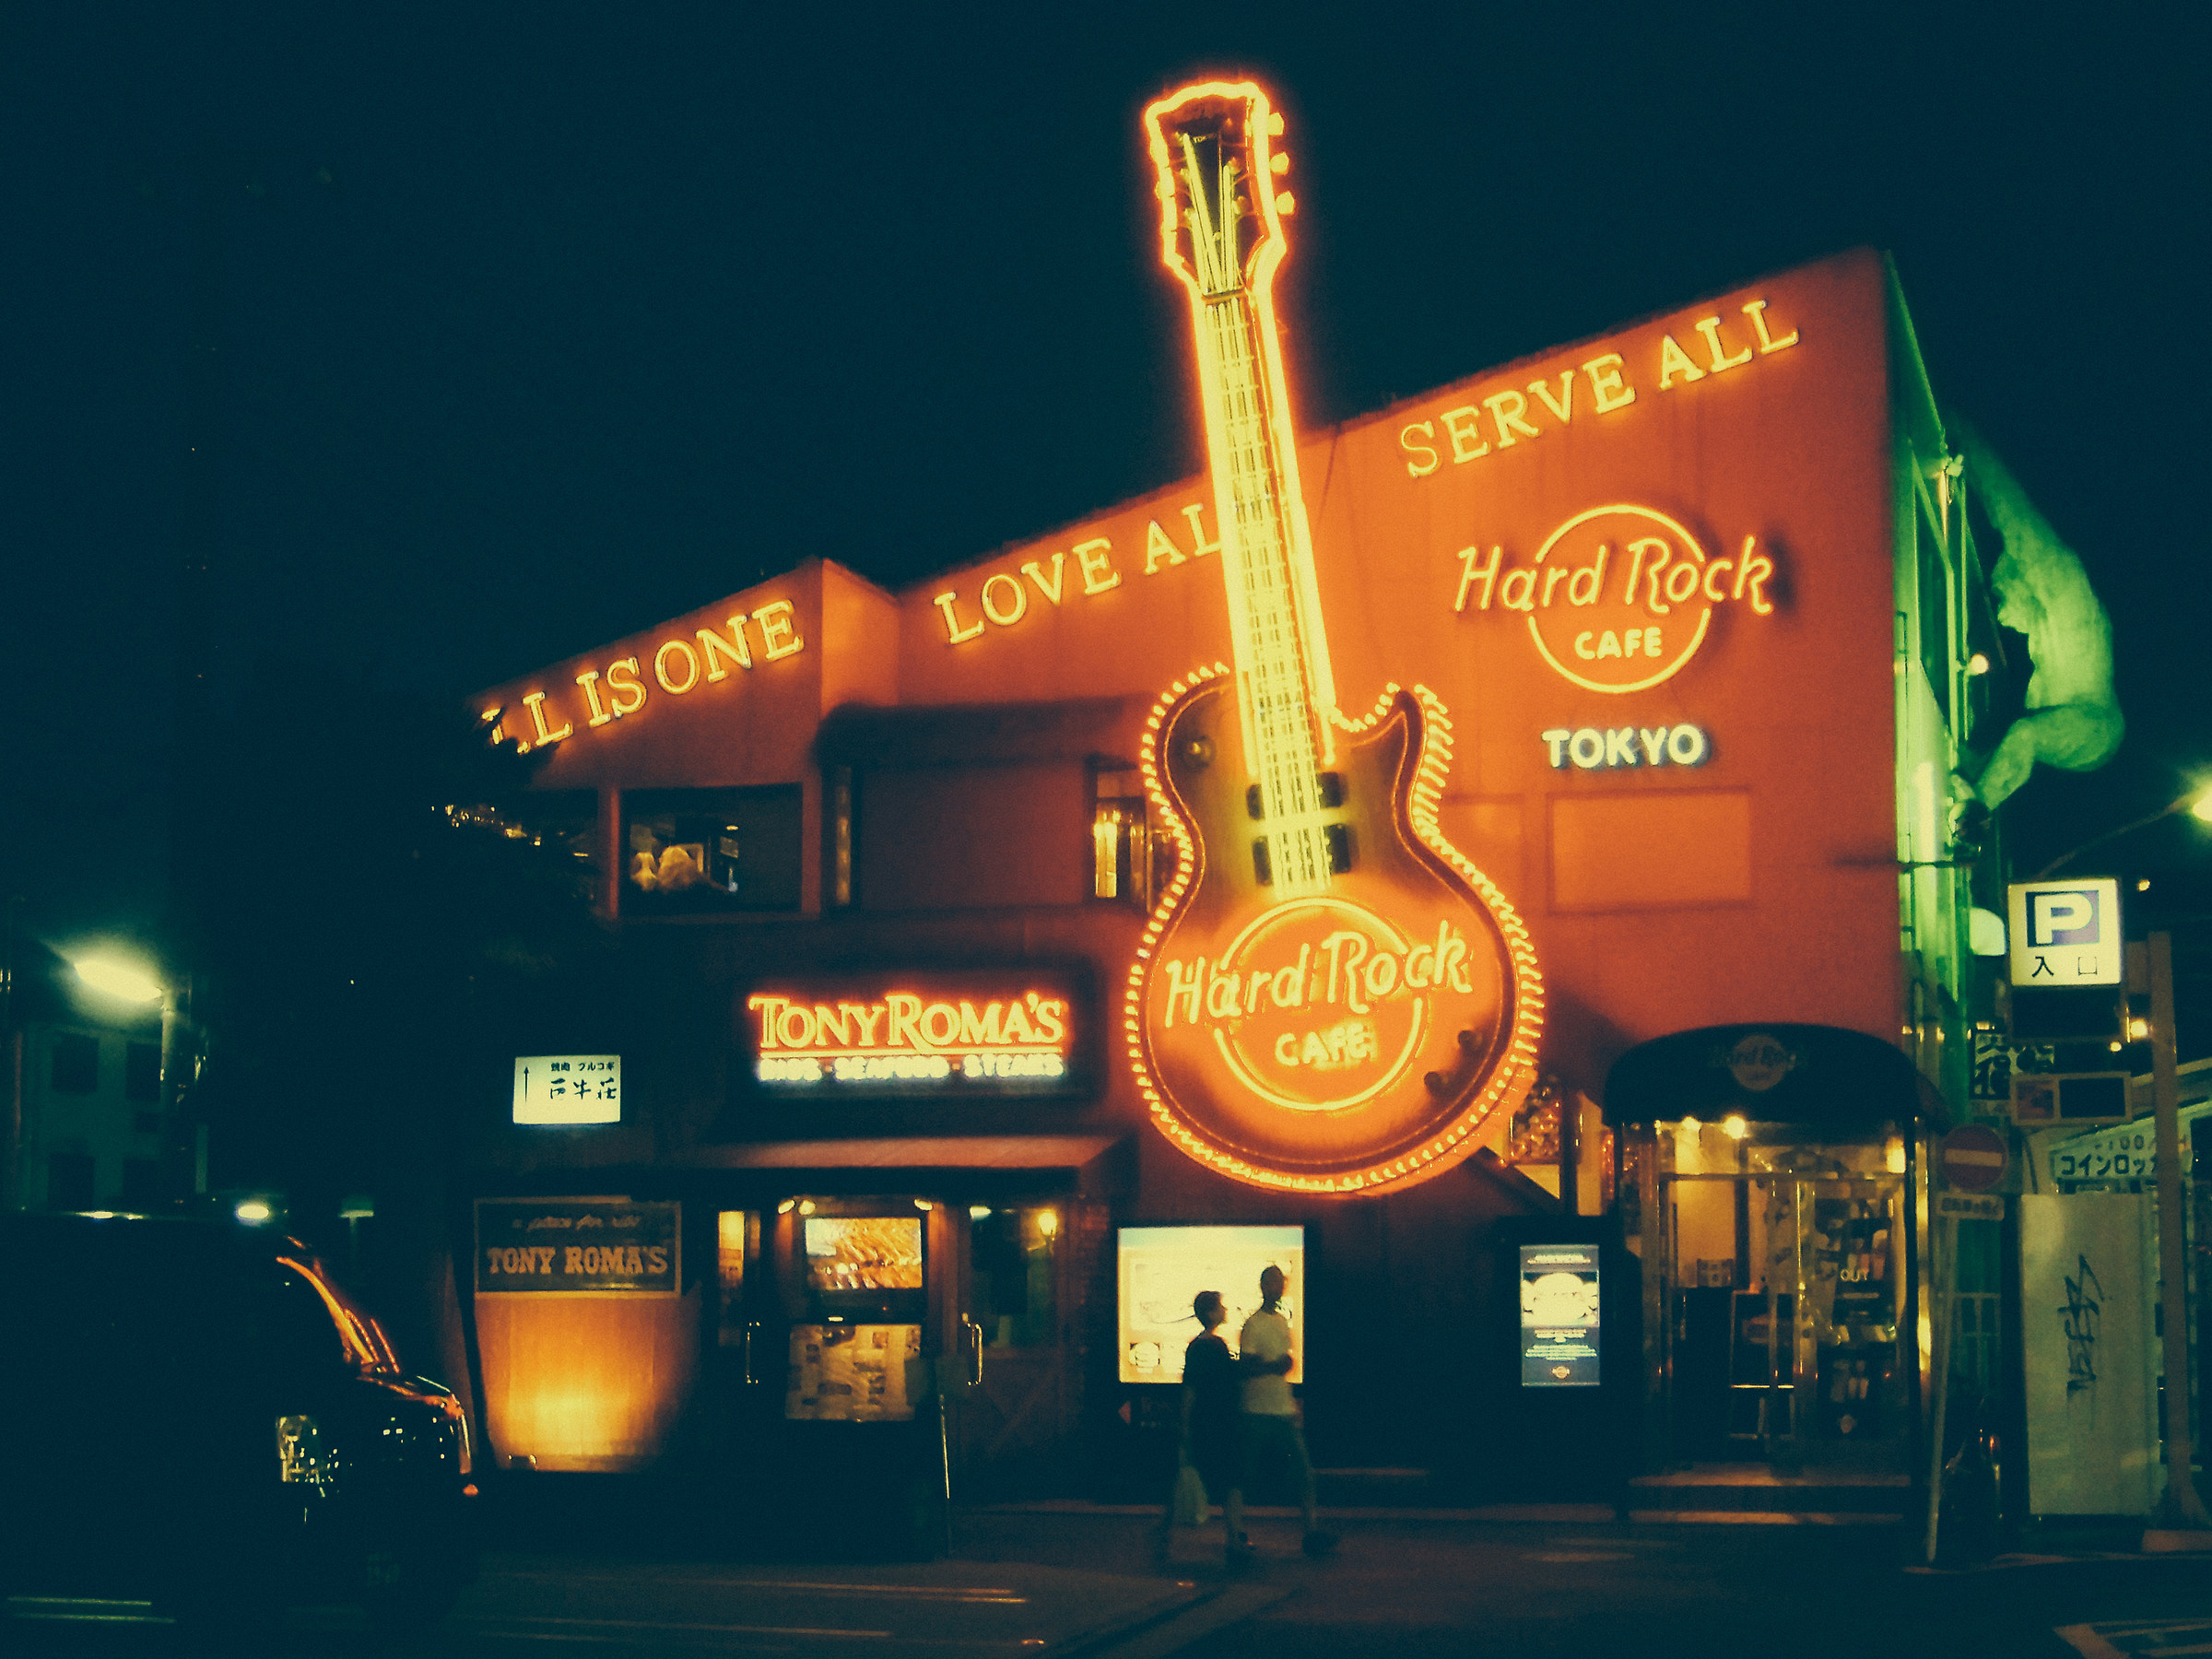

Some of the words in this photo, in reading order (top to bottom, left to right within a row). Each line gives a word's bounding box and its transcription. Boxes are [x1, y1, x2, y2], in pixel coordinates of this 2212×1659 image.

[1400, 353, 1636, 478] SERVE
[1659, 299, 1799, 391] ALL
[933, 537, 1122, 644] LOVE
[1454, 545, 1606, 612] Hard
[1625, 535, 1772, 614] Rock
[653, 599, 805, 695] ONE
[1574, 627, 1662, 659] CAFE
[1542, 724, 1709, 769] TOKYO
[2034, 893, 2094, 945] P
[1165, 943, 1310, 1028] Hard
[1322, 920, 1473, 1014] Rock
[749, 996, 885, 1048] TONY
[885, 992, 1064, 1053] ROMA'S
[1276, 1021, 1377, 1066] CAFE
[487, 1246, 556, 1275] TONY
[564, 1246, 668, 1275] ROMA'S
